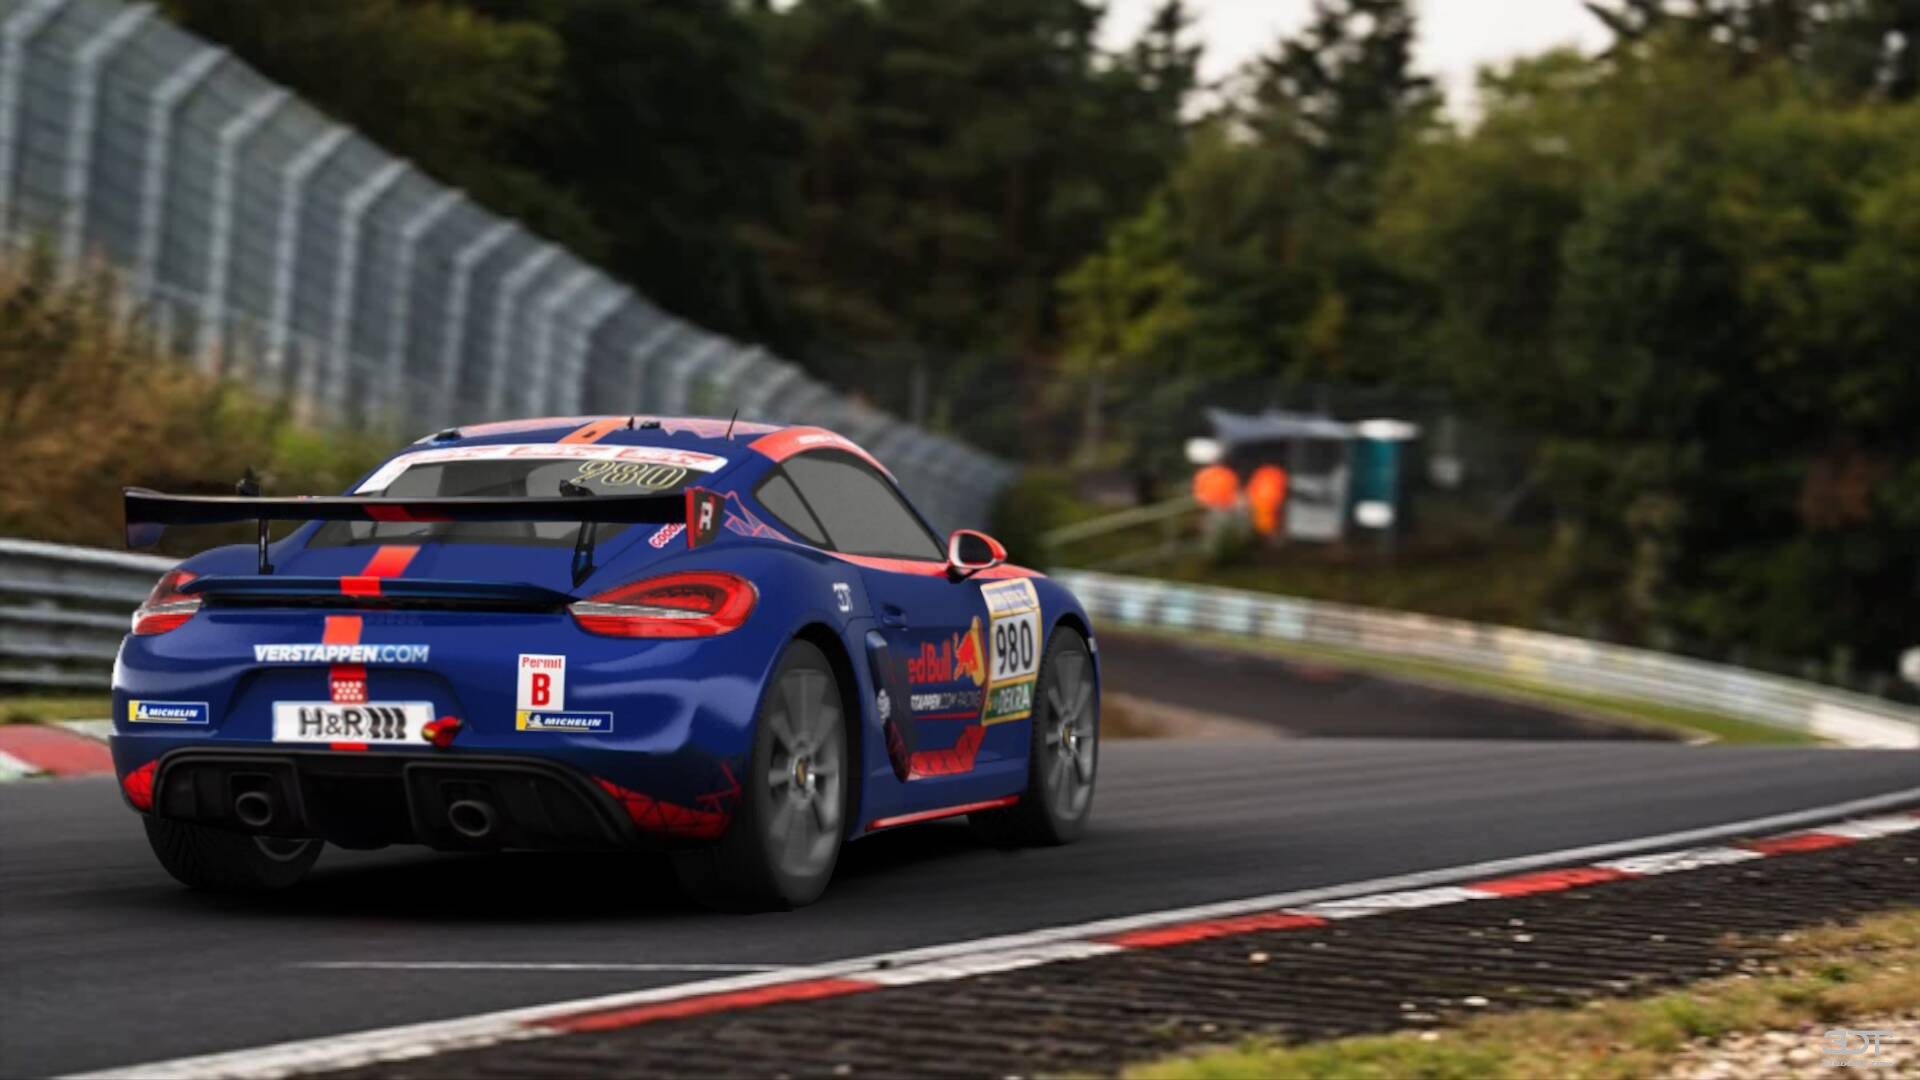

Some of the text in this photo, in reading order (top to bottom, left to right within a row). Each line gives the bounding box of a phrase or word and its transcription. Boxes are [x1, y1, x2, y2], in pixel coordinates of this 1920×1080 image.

[570, 459, 688, 490] 980
[253, 644, 430, 663] VERSTAPPEN.COM
[996, 619, 1033, 675] 980
[521, 656, 563, 669] Permit
[926, 638, 952, 684] Bull
[531, 673, 551, 706] B
[148, 708, 199, 718] MICHELIN
[543, 717, 602, 727] MICHELIN
